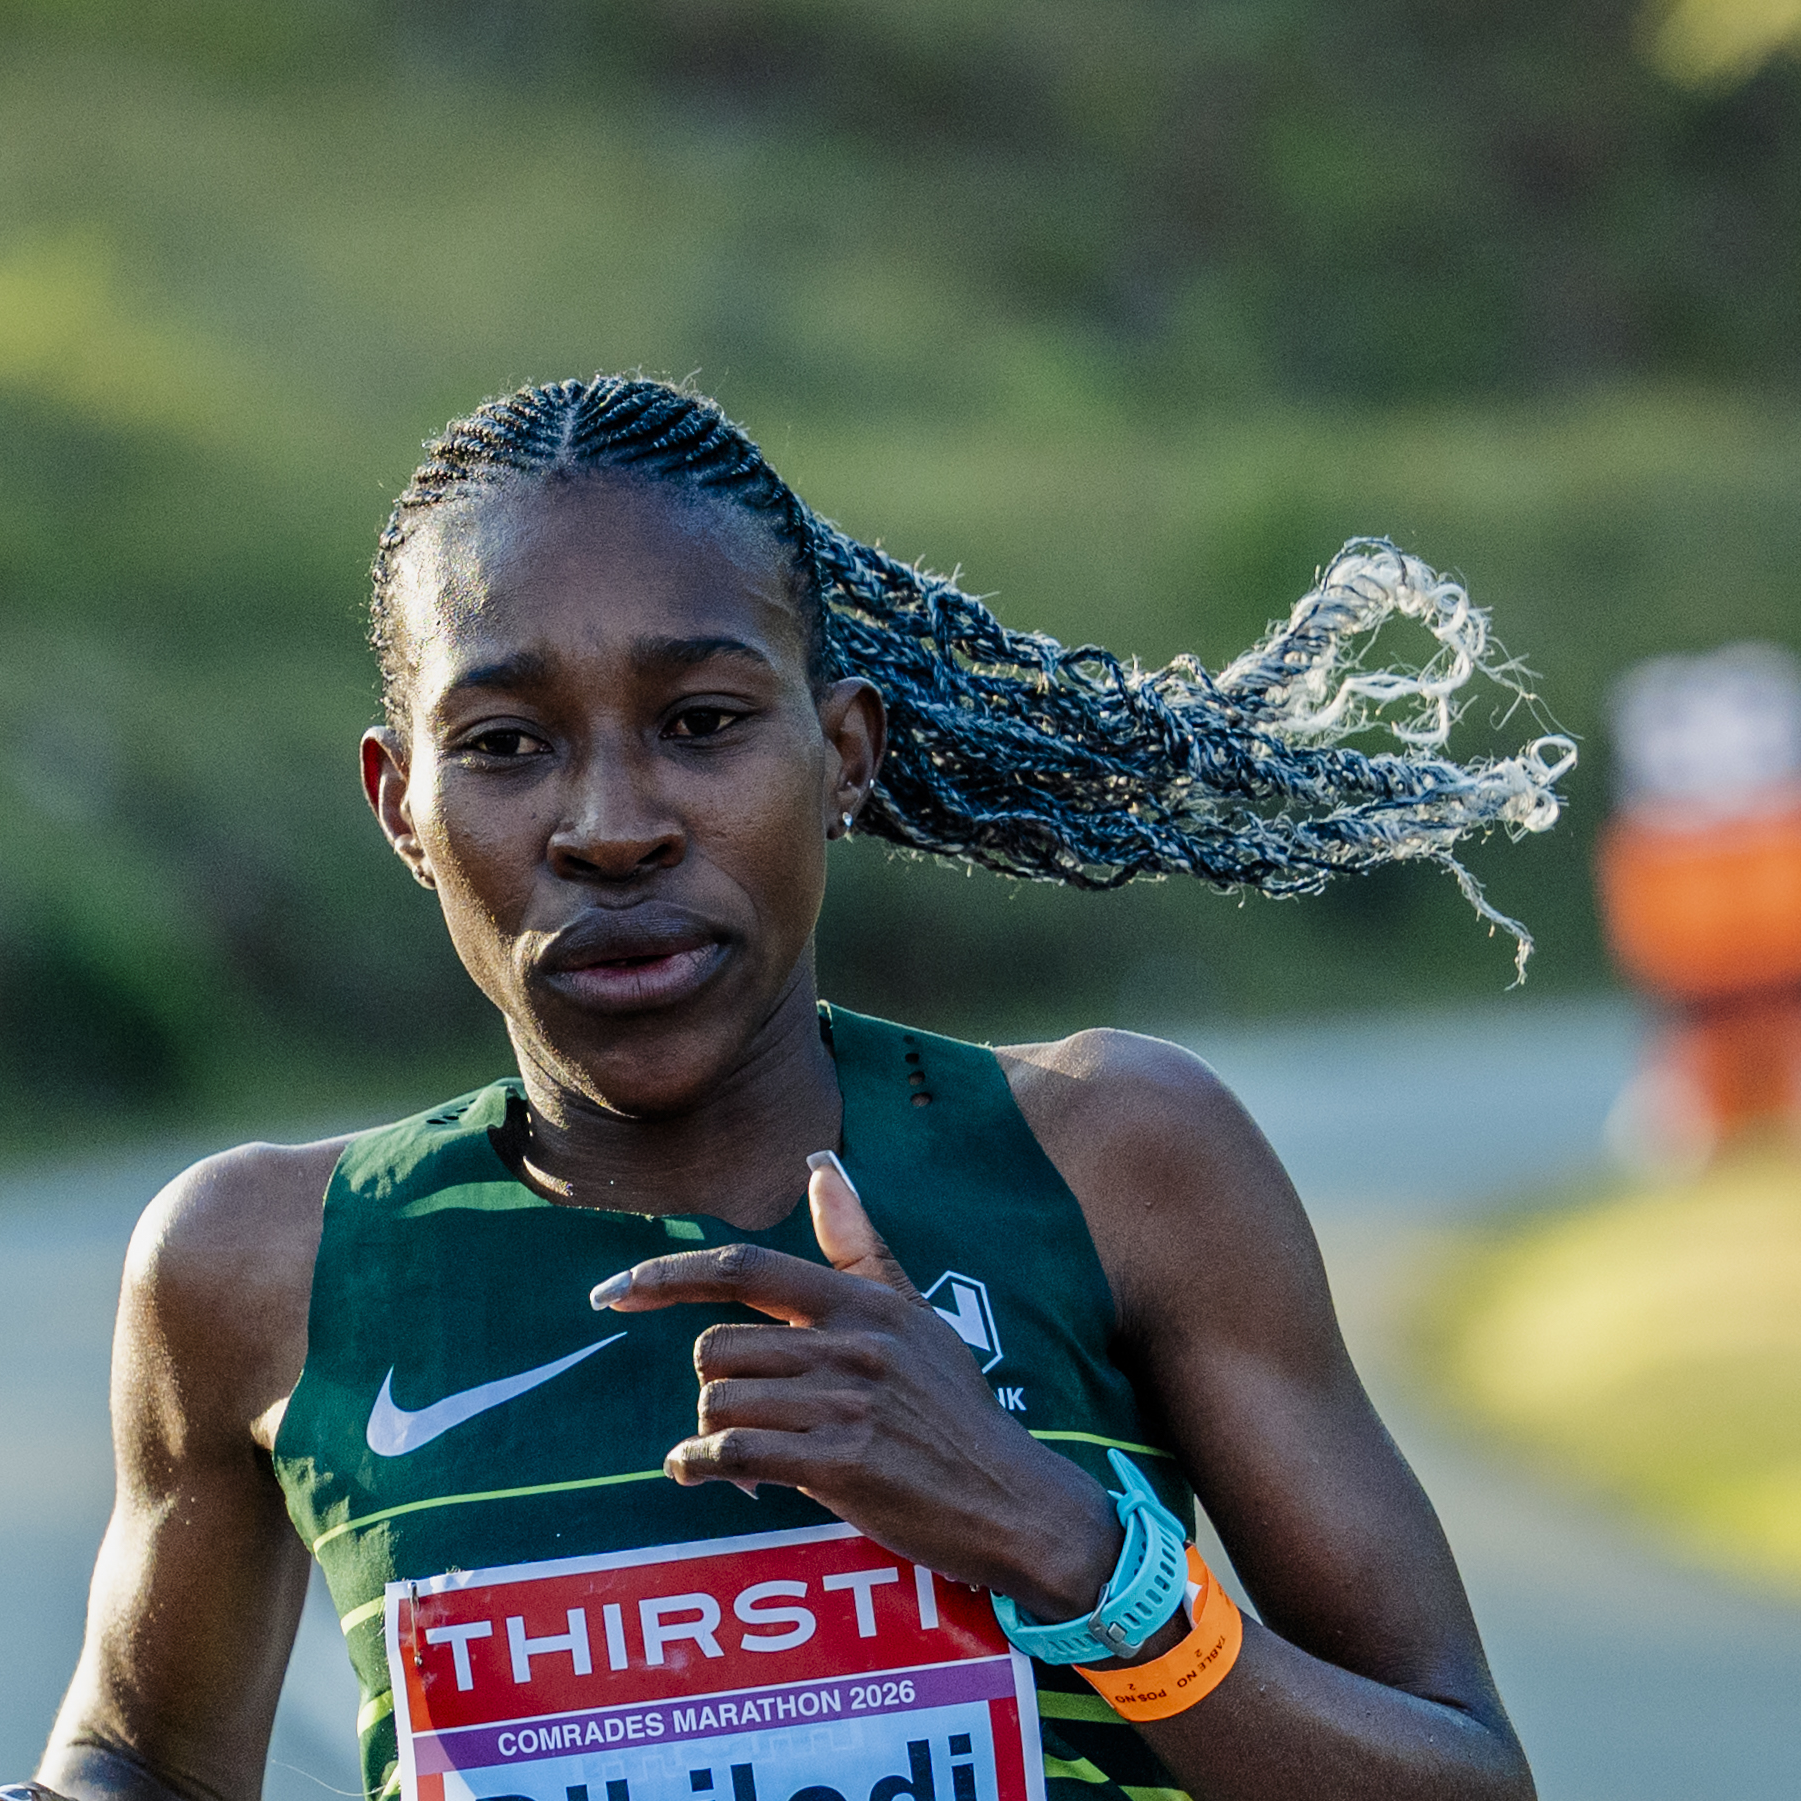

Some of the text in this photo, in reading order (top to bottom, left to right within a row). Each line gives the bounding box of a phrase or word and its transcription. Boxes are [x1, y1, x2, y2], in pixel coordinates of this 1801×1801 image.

[425, 1565, 939, 1692] THIRSTI
[1199, 1635, 1226, 1672] TABLE
[1115, 1689, 1167, 1704] POS NO
[1177, 1670, 1198, 1688] NO
[497, 1680, 916, 1757] COMRADES MARATHON 2026
